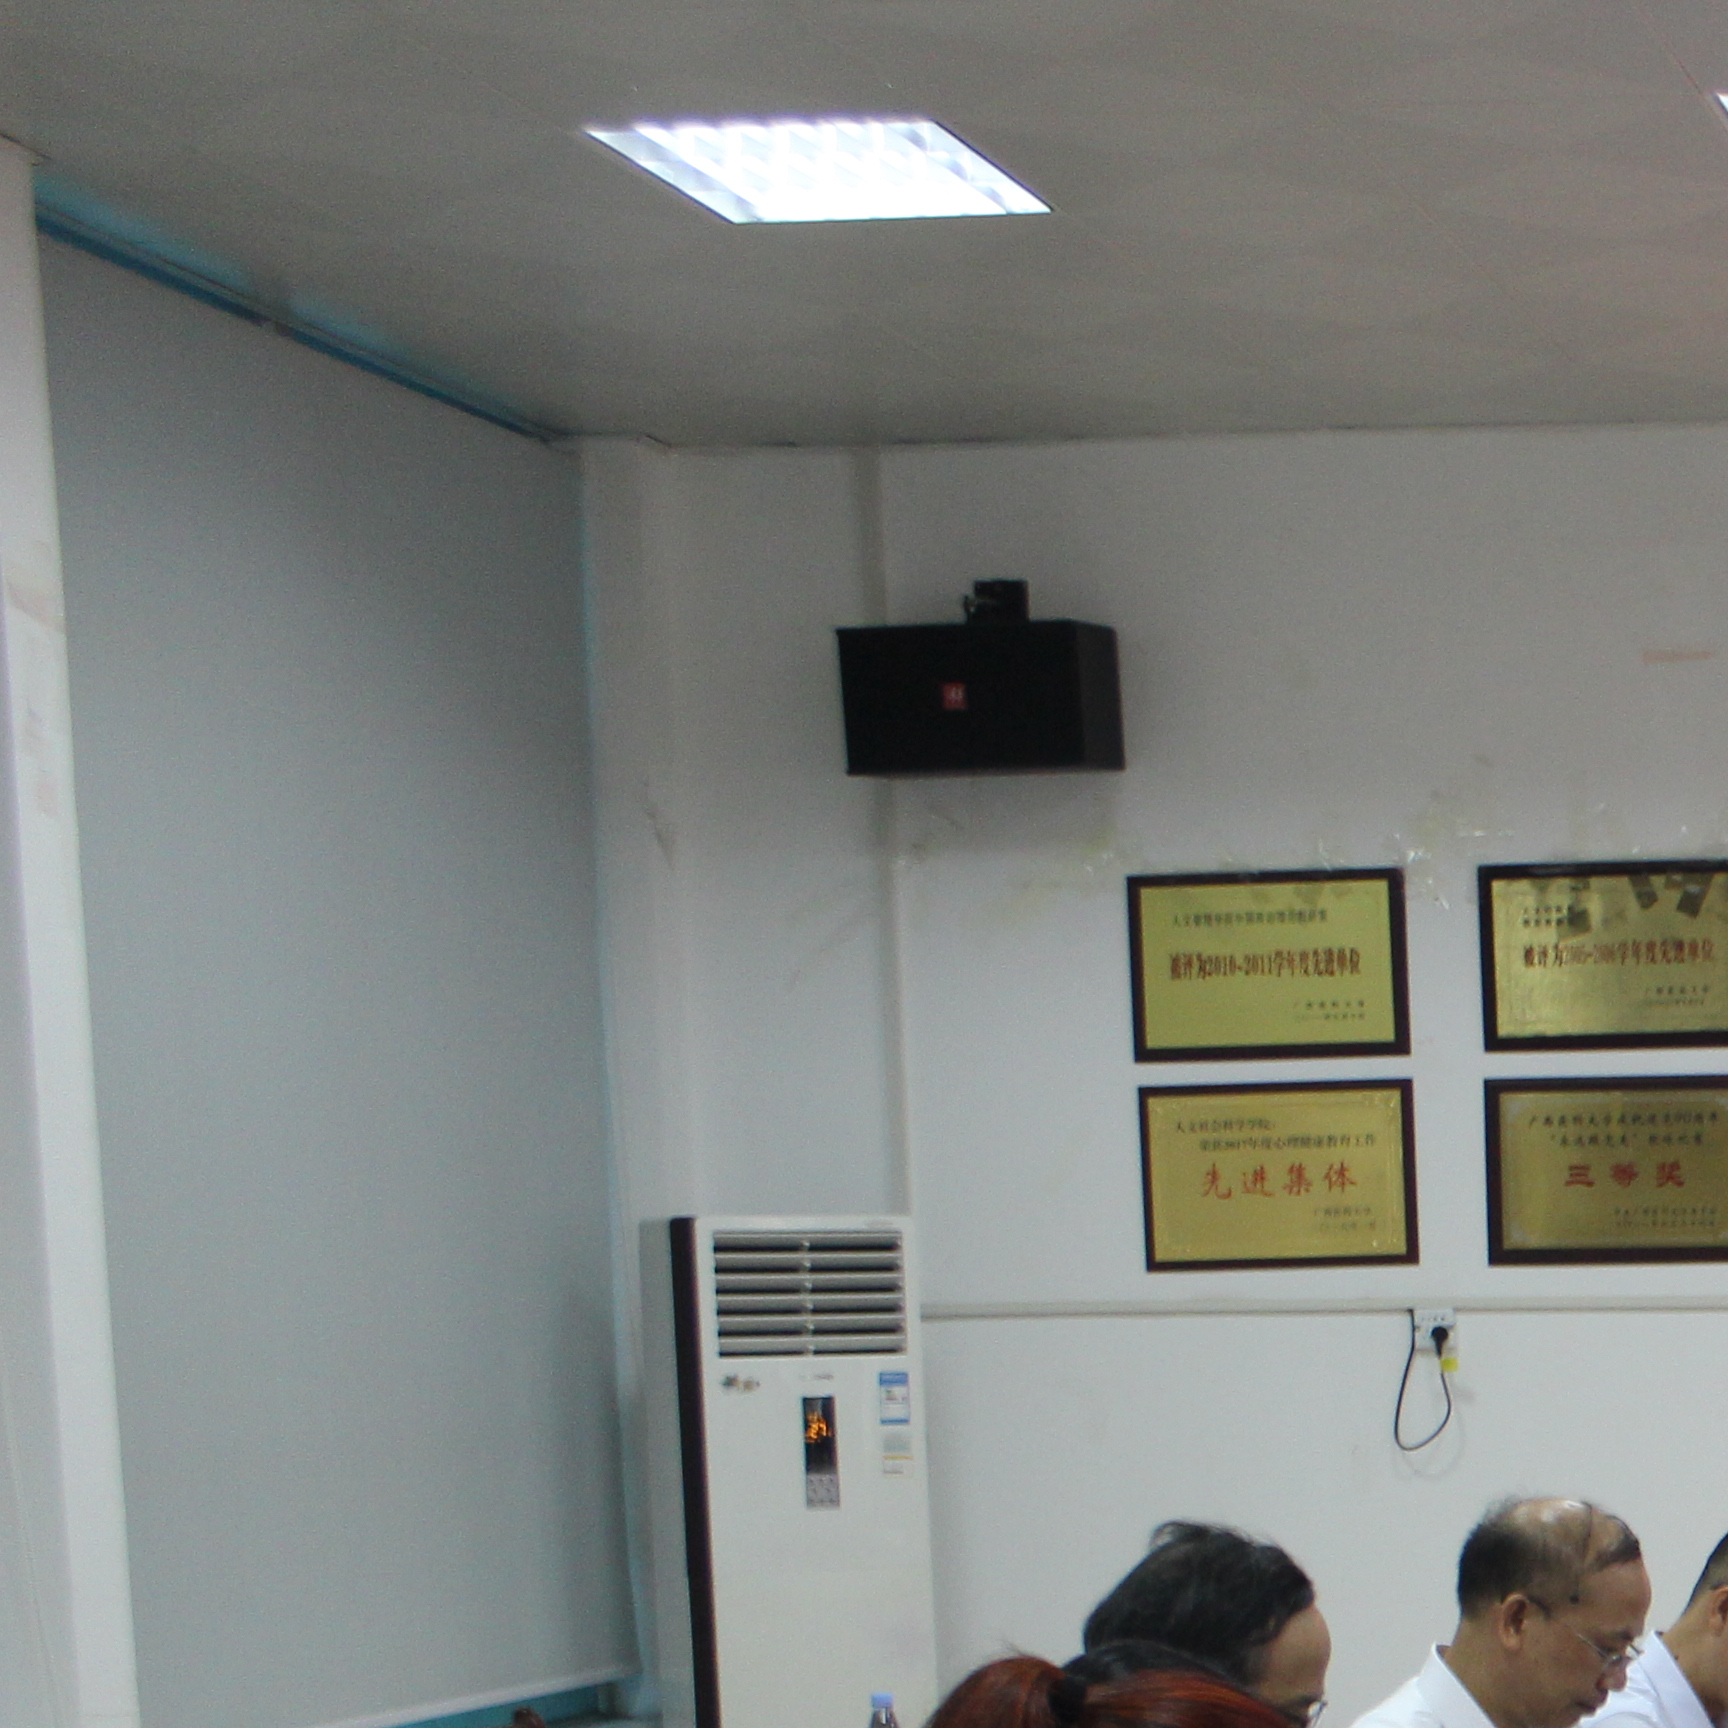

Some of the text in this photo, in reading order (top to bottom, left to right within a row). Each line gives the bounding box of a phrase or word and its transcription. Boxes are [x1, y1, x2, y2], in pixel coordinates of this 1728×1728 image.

[1200, 1158, 1359, 1201] 先进集体
[1564, 1160, 1686, 1189] 三等奖
